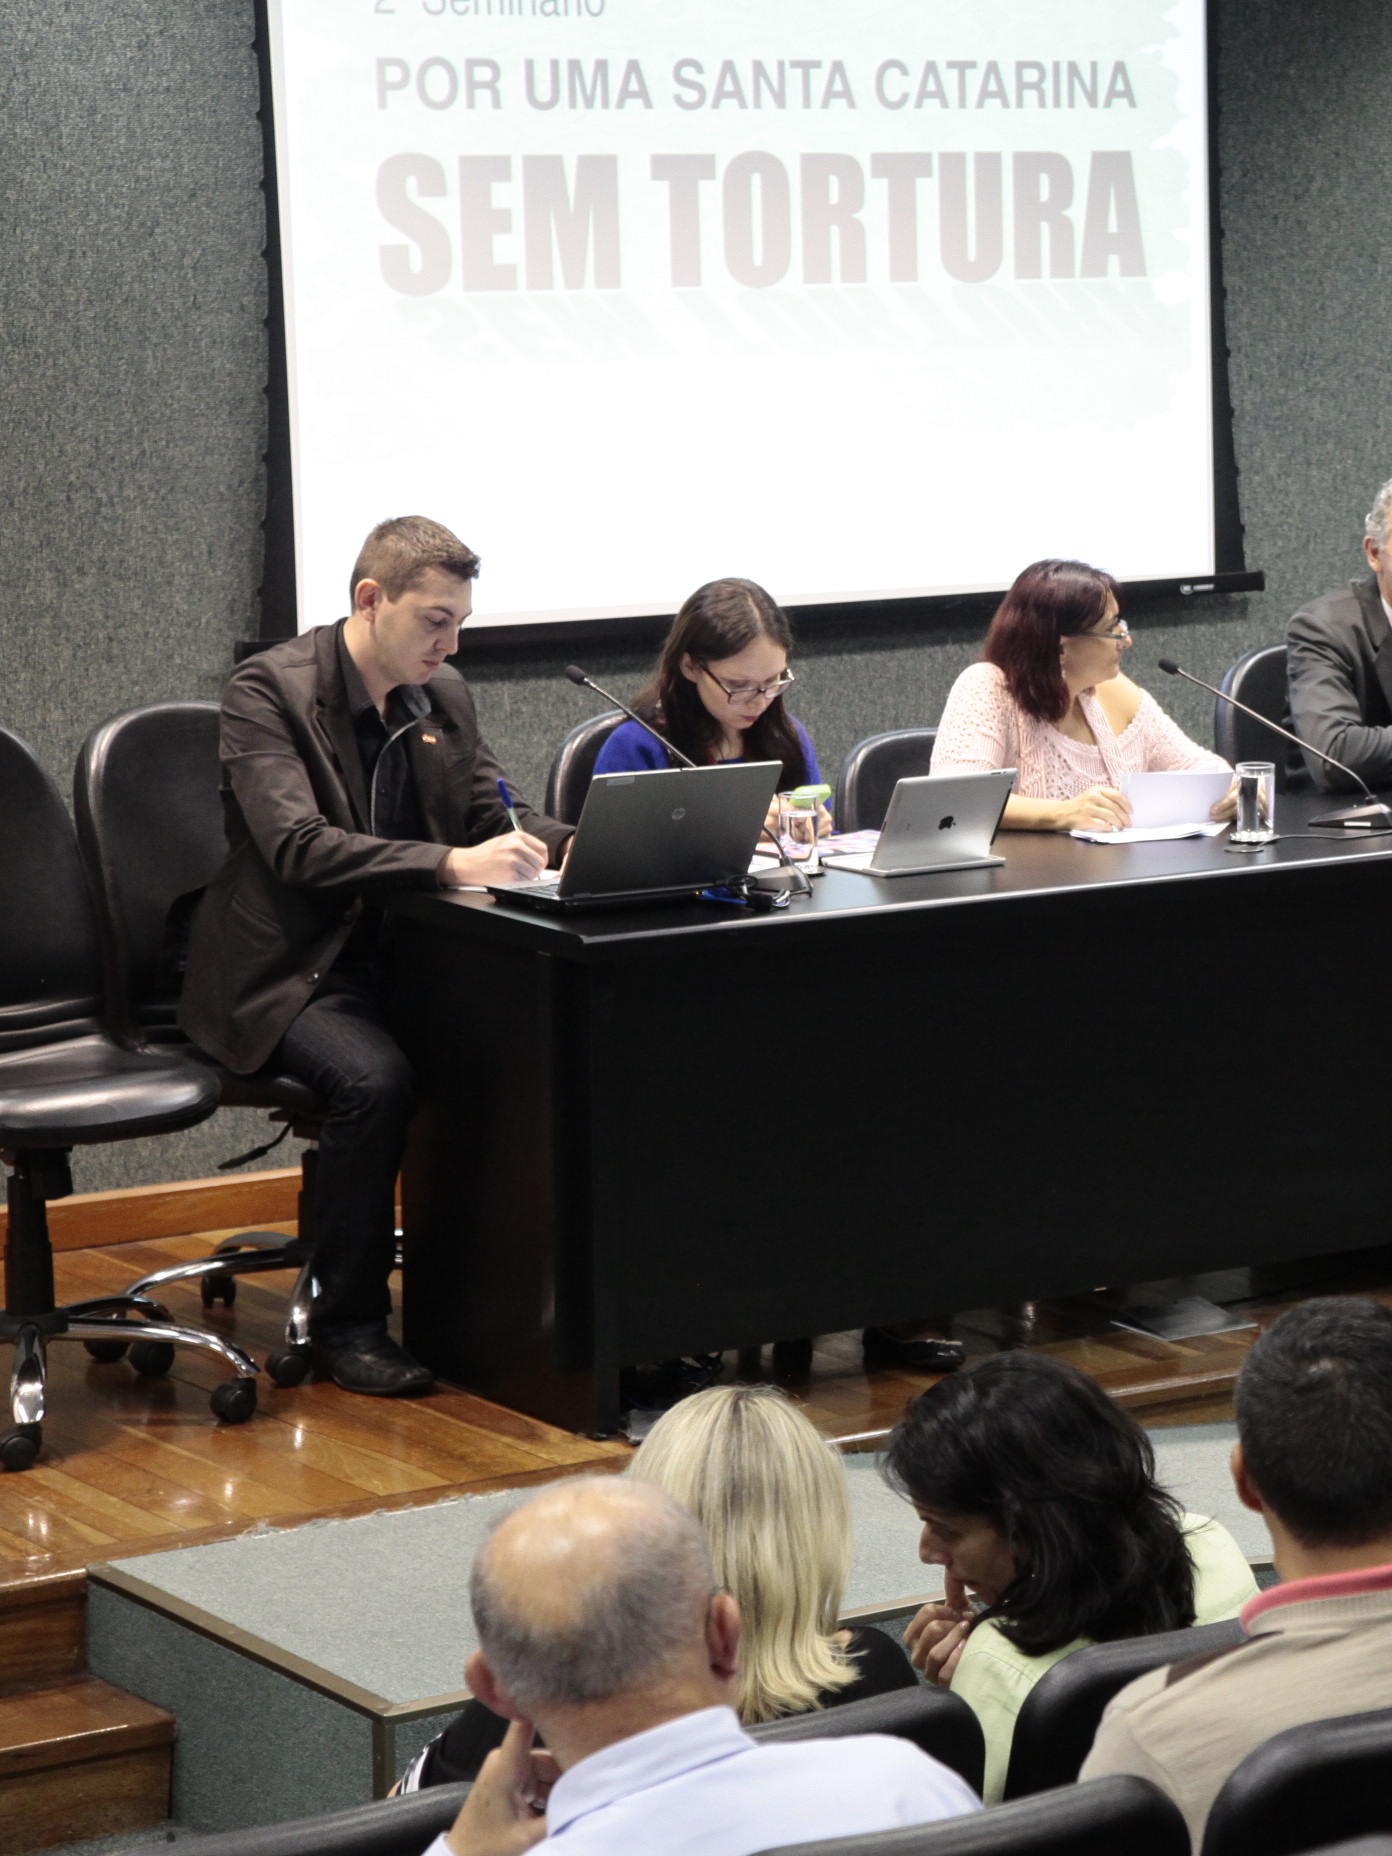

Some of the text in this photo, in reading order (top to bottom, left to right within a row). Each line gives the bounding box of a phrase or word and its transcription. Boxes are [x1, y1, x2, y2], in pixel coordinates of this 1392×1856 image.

[375, 57, 1138, 110] POR UMA SANTA CATARINA
[374, 149, 1148, 297] SEM TORTURA
